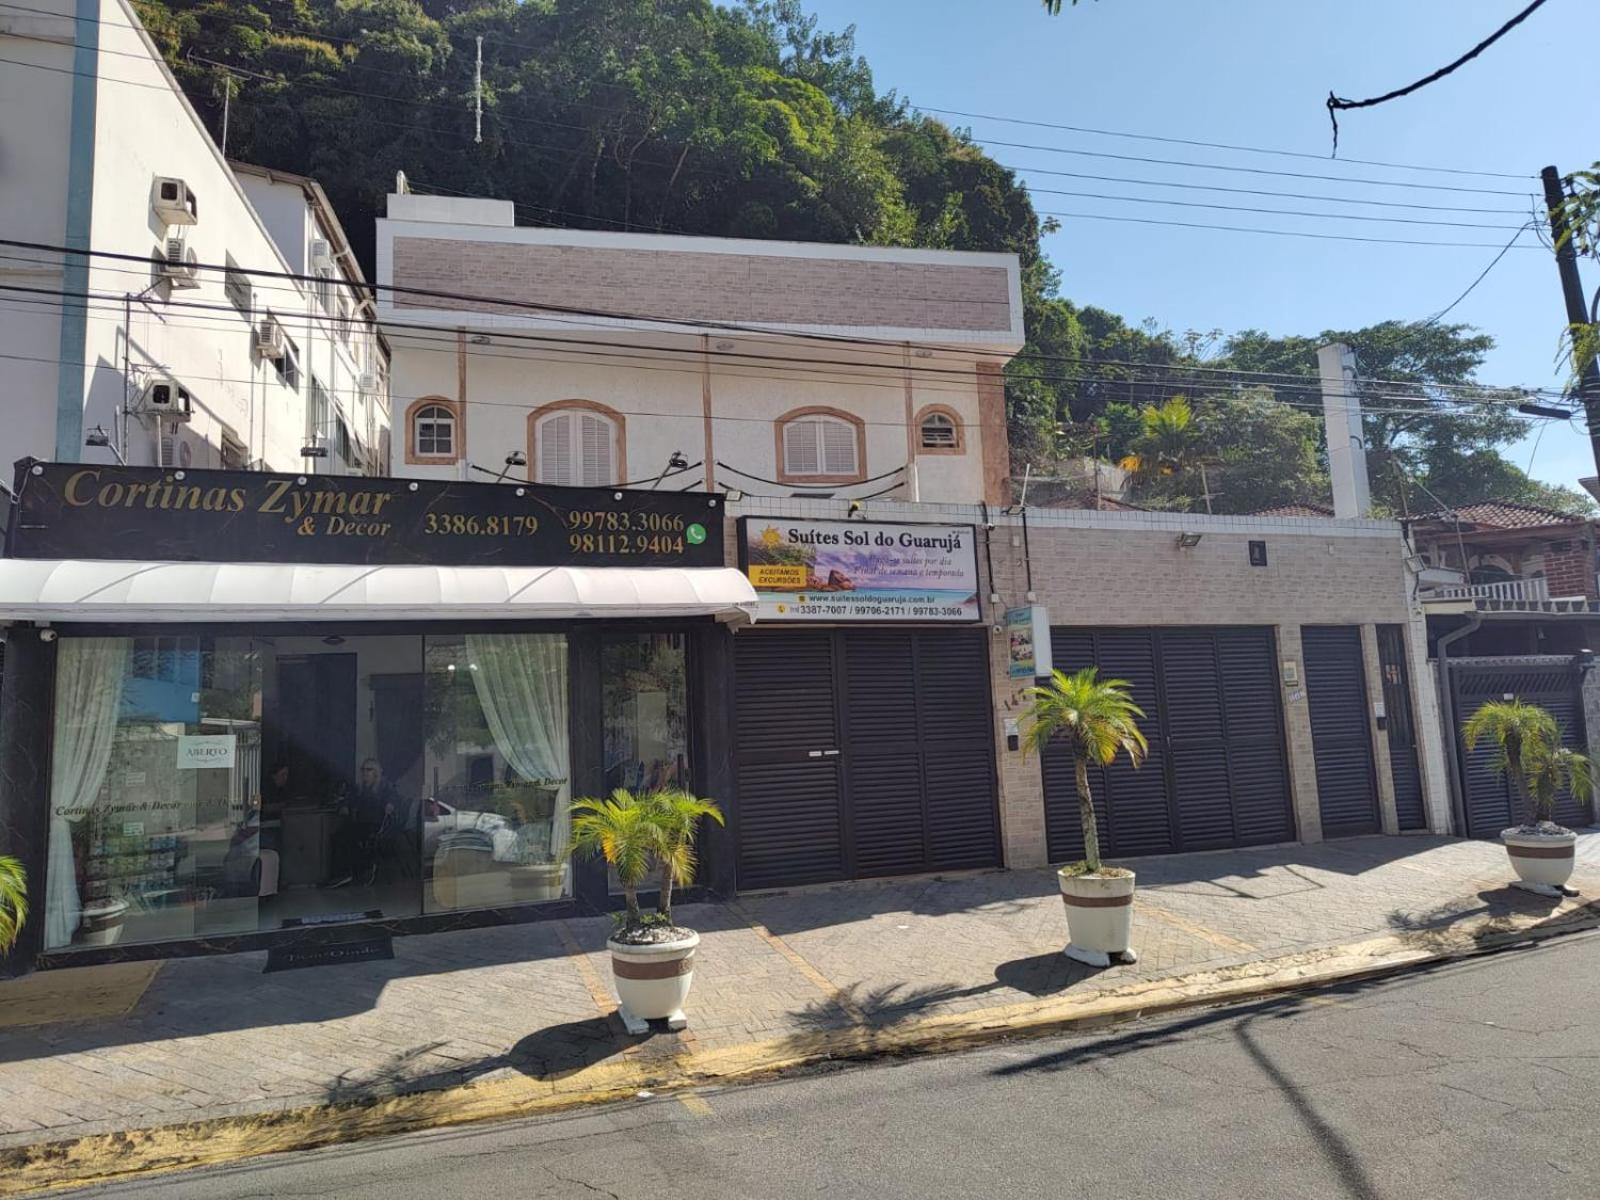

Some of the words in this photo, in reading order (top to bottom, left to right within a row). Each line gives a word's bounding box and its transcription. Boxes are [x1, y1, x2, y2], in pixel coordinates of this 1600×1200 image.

[64, 469, 247, 513] Cortinas
[258, 480, 392, 523] Zymar
[297, 516, 316, 536] &
[325, 517, 391, 537] Decor
[424, 512, 538, 536] 3386.8179
[568, 510, 685, 533] 99783.3066
[569, 533, 685, 555] 98112.9404
[788, 528, 839, 546] Suítes
[844, 530, 869, 546] Sol
[874, 531, 894, 547] do
[899, 533, 962, 553] Guarujá
